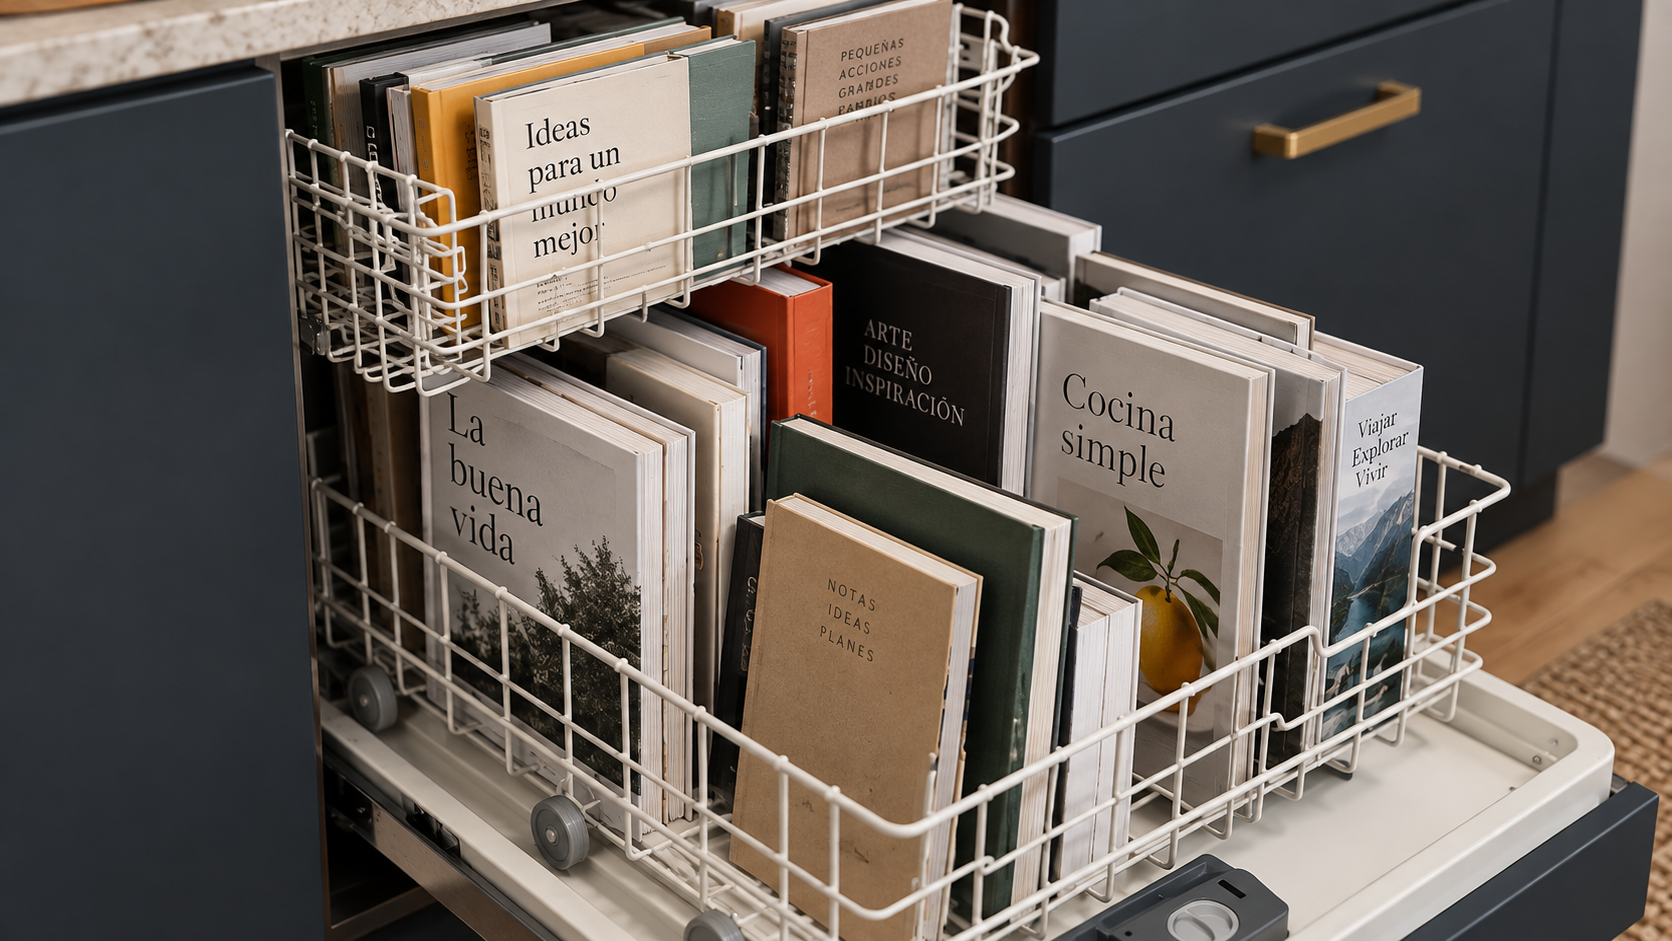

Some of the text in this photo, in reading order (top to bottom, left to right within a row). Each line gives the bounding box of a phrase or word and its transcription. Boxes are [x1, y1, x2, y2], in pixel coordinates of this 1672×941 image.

[838, 56, 902, 80] ACCIONES
[838, 73, 899, 99] GRANDES
[525, 116, 591, 150] Ideas
[527, 146, 621, 195] para un
[863, 318, 913, 352] ARTE
[863, 343, 933, 386] DISEÑO
[447, 391, 486, 447] La
[1062, 372, 1176, 443] Cocina
[1357, 412, 1398, 439] Viajar
[1061, 423, 1166, 489] simple
[1351, 431, 1409, 468] Explorar
[448, 442, 544, 527] buena
[1355, 462, 1389, 488] Vivir
[449, 504, 516, 566] vida
[827, 577, 876, 612] NOTAS
[828, 603, 871, 635] IDEAS
[819, 624, 874, 662] PLANES
